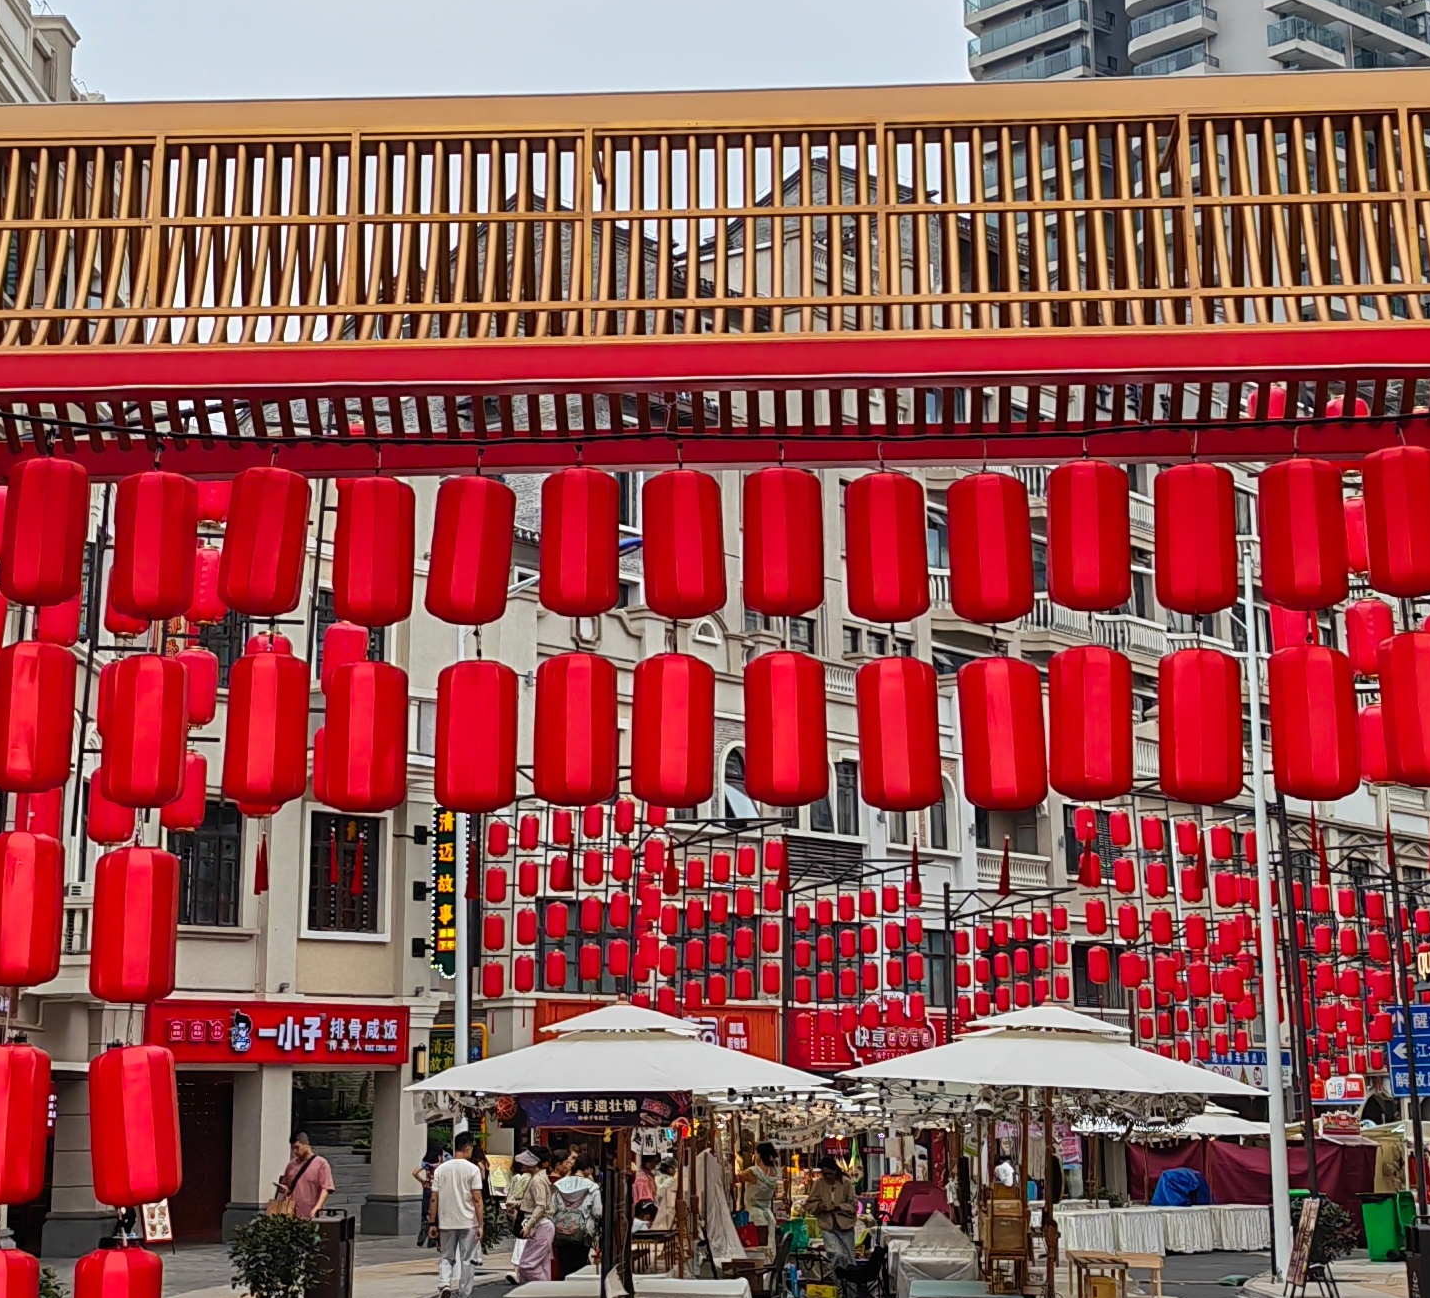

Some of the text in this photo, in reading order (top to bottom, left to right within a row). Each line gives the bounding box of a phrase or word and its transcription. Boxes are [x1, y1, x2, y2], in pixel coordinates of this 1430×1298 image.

[437, 810, 455, 926] 清迈故事
[258, 1016, 323, 1052] 一小子
[329, 1017, 399, 1041] 排骨咸饭
[430, 1038, 455, 1055] 清迈
[550, 1098, 638, 1114] 广西非遗壮锦
